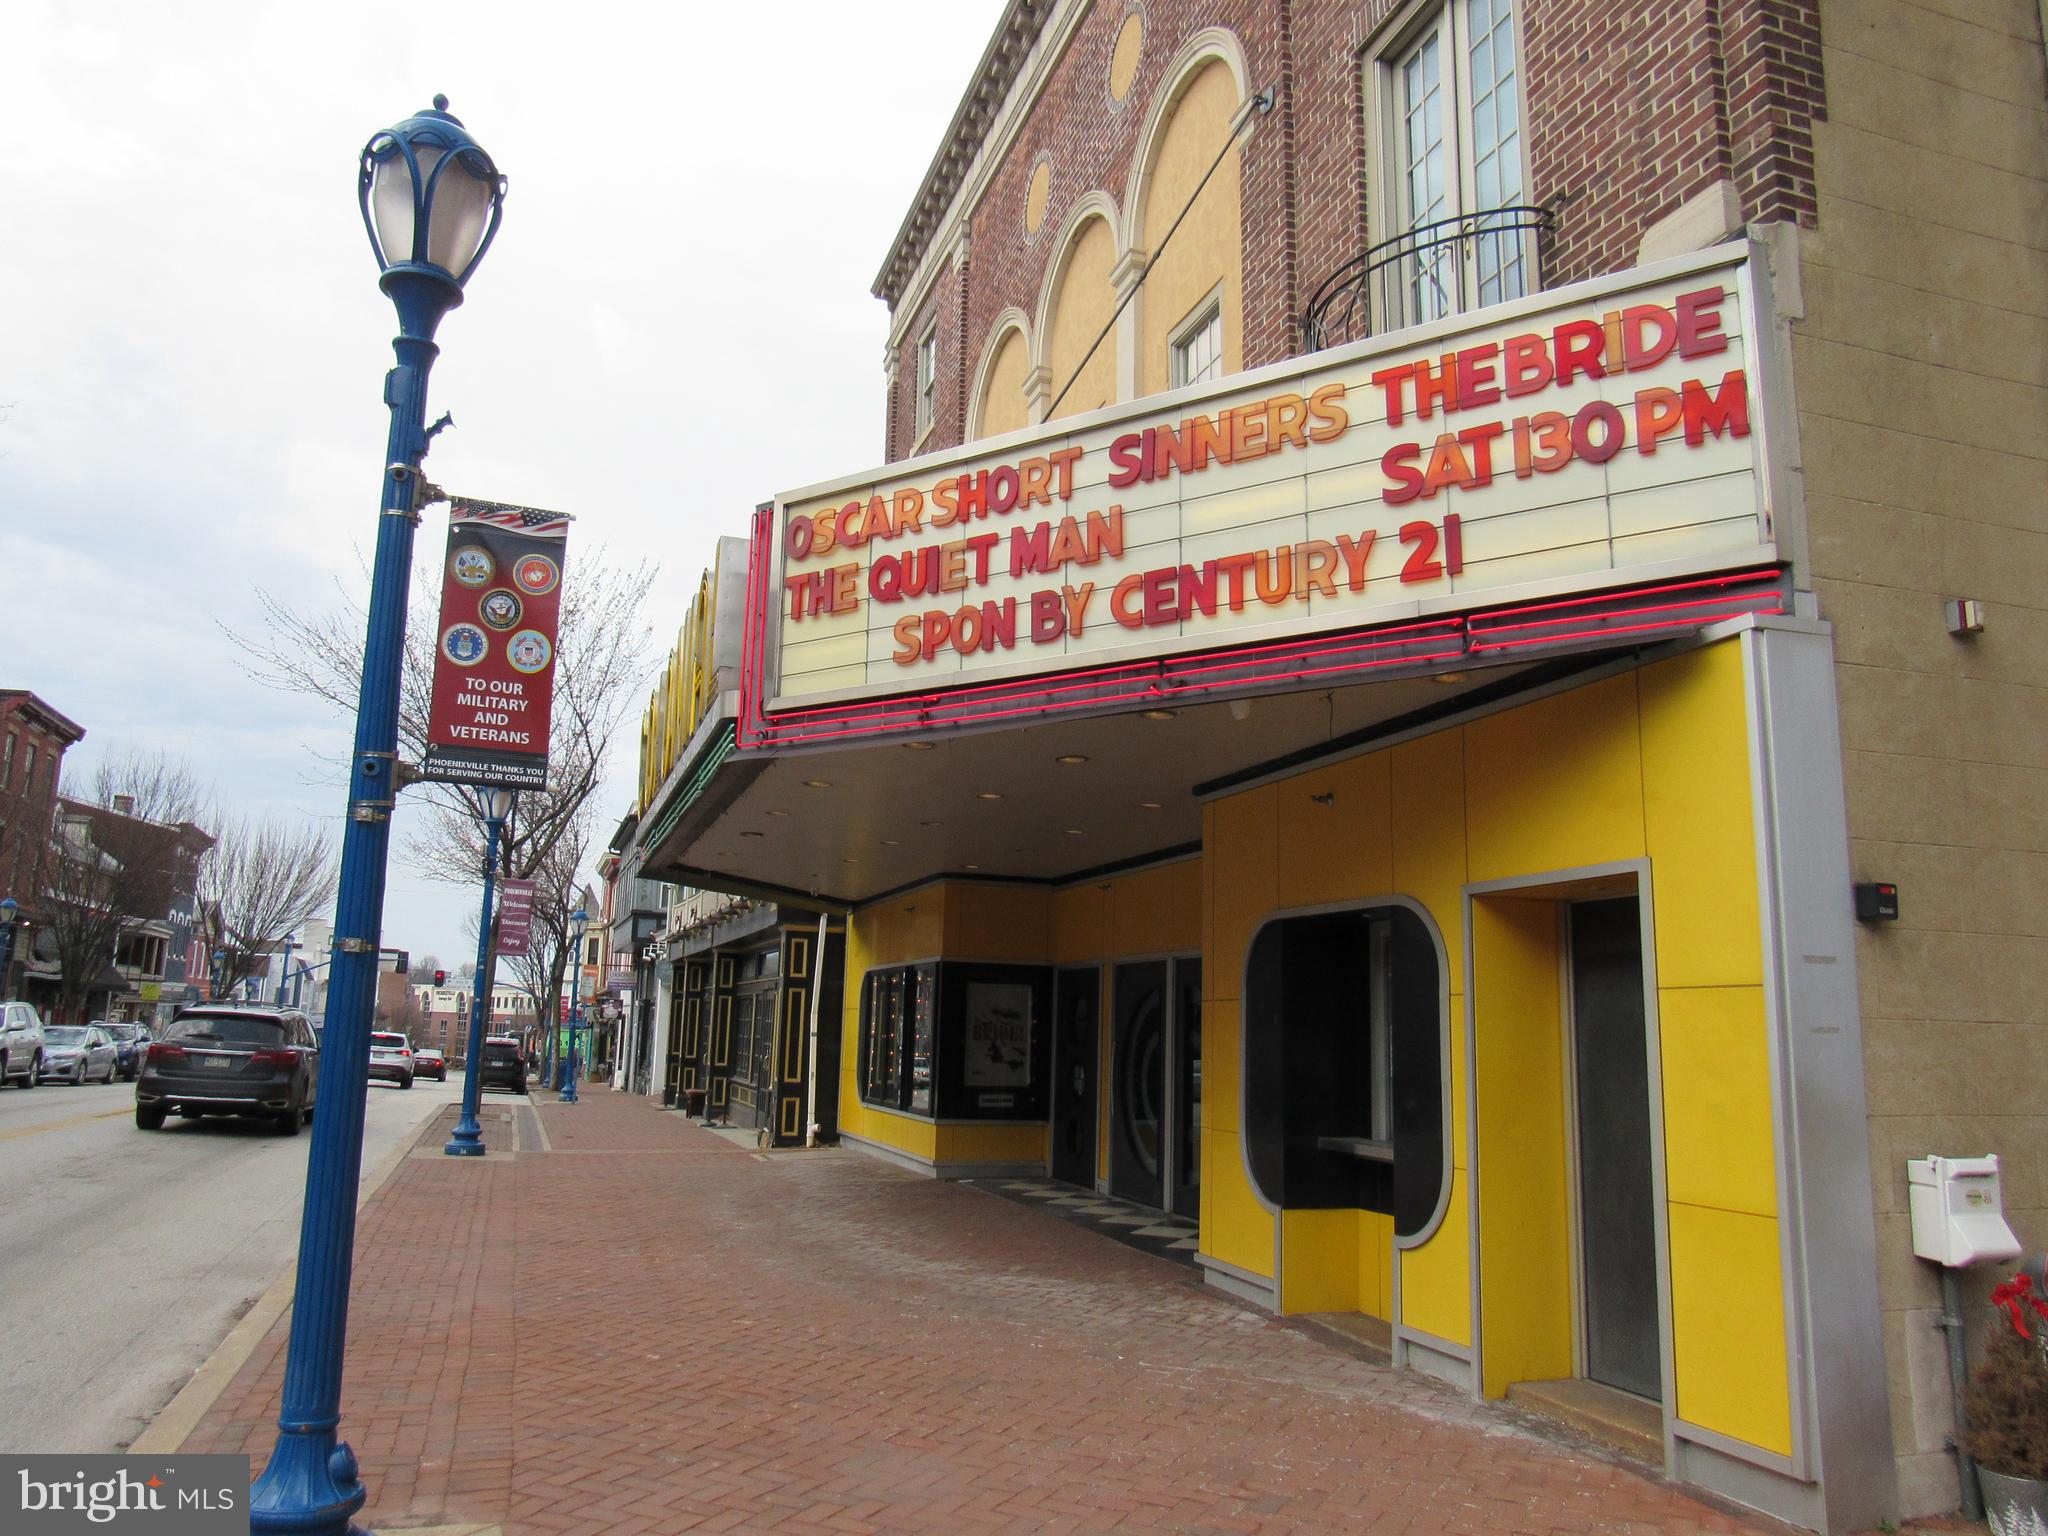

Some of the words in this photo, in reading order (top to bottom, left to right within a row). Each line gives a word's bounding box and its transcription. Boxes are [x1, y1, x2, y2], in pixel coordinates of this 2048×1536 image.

[1380, 421, 1504, 505] SAT
[1513, 400, 1626, 479] 130
[1634, 369, 1750, 455] PM
[784, 487, 924, 560] OSCAR
[931, 446, 1082, 528] SHORT
[1108, 382, 1348, 488] SINNERS
[784, 561, 859, 620] THE
[867, 532, 998, 603] QUIET
[1009, 504, 1124, 579] MAN
[892, 596, 1016, 665] SPON
[1030, 582, 1094, 644] BY
[1109, 528, 1377, 629] CENTURY
[1399, 513, 1464, 584] 21
[466, 677, 486, 691] TO
[490, 680, 523, 695] OUR
[457, 693, 528, 712] MILITARY
[474, 711, 509, 726] AND
[450, 725, 530, 744] VETERANS
[427, 766, 445, 775] FOR
[447, 768, 483, 779] SERVING
[484, 772, 503, 781] OUR
[505, 774, 544, 784] COUNTRY
[429, 758, 489, 771] PHOENIXVILLE
[491, 764, 524, 774] THANKS
[526, 767, 544, 776] YOU
